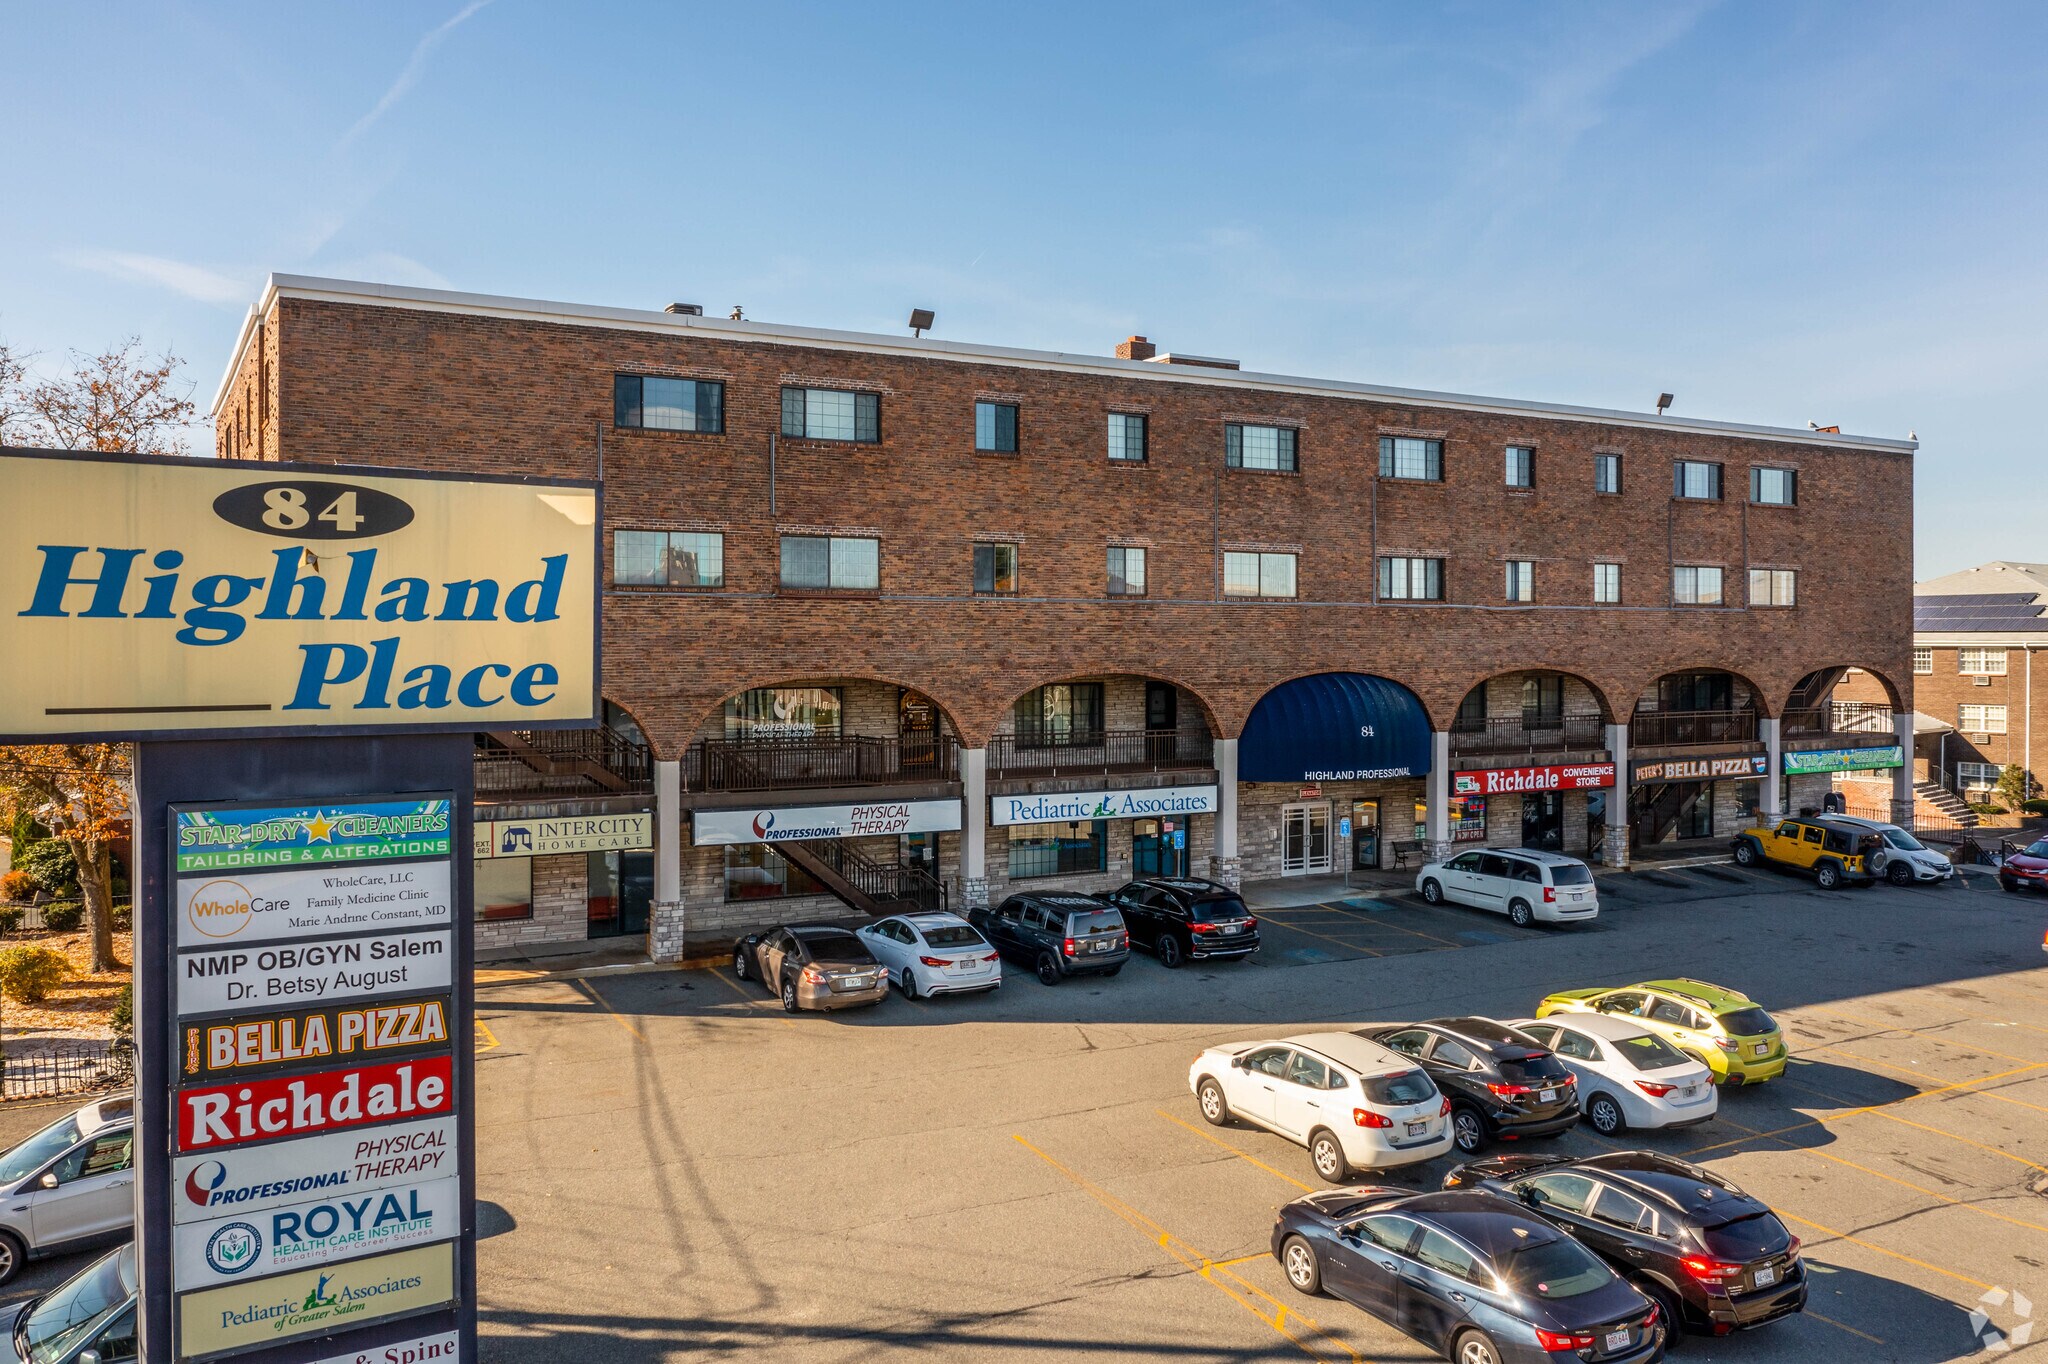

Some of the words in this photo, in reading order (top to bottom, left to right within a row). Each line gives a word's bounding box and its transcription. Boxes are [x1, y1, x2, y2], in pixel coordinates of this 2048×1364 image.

[261, 487, 364, 531] 84
[18, 545, 568, 646] Highland
[282, 636, 559, 710] Place
[752, 723, 816, 731] PROFESSIONAL
[1361, 725, 1374, 737] 84
[1305, 771, 1354, 780] HIGHLAND
[1356, 767, 1410, 779] PROFESSIONAL
[1487, 768, 1559, 793] Richdale
[1563, 766, 1614, 777] CONVENIENCE
[1576, 777, 1601, 786] STORE
[1636, 763, 1663, 780] PETER'S
[1665, 760, 1709, 779] BELLA
[1711, 758, 1751, 775] PIZZA
[851, 805, 911, 820] PHYSICAL
[1009, 797, 1090, 820] Pediatric
[1120, 792, 1208, 814] Associates
[180, 824, 243, 848] STAR
[251, 821, 301, 842] DRY
[338, 813, 448, 837] CLEANERS
[538, 818, 644, 838] INTERCITY
[766, 827, 842, 840] PROFESSIONAL
[851, 819, 910, 834] THERAPY
[182, 850, 292, 868] TAILORING
[301, 849, 314, 860] &
[322, 841, 448, 858] ALTERATIONS
[476, 840, 490, 848] EXT.
[538, 839, 587, 850] HOME
[598, 836, 642, 847] CARE
[323, 874, 386, 888] WholeCare,
[390, 872, 414, 884] LLC
[307, 896, 344, 908] Family
[347, 892, 396, 905] Medicine
[398, 889, 429, 900] Clinic
[288, 917, 320, 928] Marie
[371, 910, 422, 921] Constant,
[425, 904, 446, 916] MD
[187, 954, 248, 978] NMP
[257, 943, 361, 971] OB/GYN
[370, 940, 443, 960] Salem
[227, 981, 258, 1000] Dr.
[267, 974, 328, 998] Betsy
[334, 966, 408, 990] August
[209, 1016, 331, 1070] BELLA
[340, 1002, 447, 1052] PIZZA
[188, 1066, 444, 1144] Richdale
[355, 1130, 446, 1160] PHYSICAL
[355, 1152, 445, 1182] THERAPY
[210, 1170, 349, 1206] PROFESSIONAL
[272, 1189, 433, 1246] ROYAL
[273, 1239, 326, 1257] HEALTH
[329, 1230, 364, 1246] CARE
[368, 1218, 432, 1238] INSTITUTE
[273, 1249, 328, 1265] Educating
[332, 1244, 350, 1253] For
[354, 1236, 389, 1249] Career
[393, 1228, 434, 1241] Success
[221, 1298, 298, 1328] Pediatric
[339, 1275, 422, 1303] Associates
[274, 1316, 286, 1332] of
[288, 1309, 330, 1327] Greater
[332, 1300, 366, 1317] Salem
[384, 1340, 456, 1364] Spine
